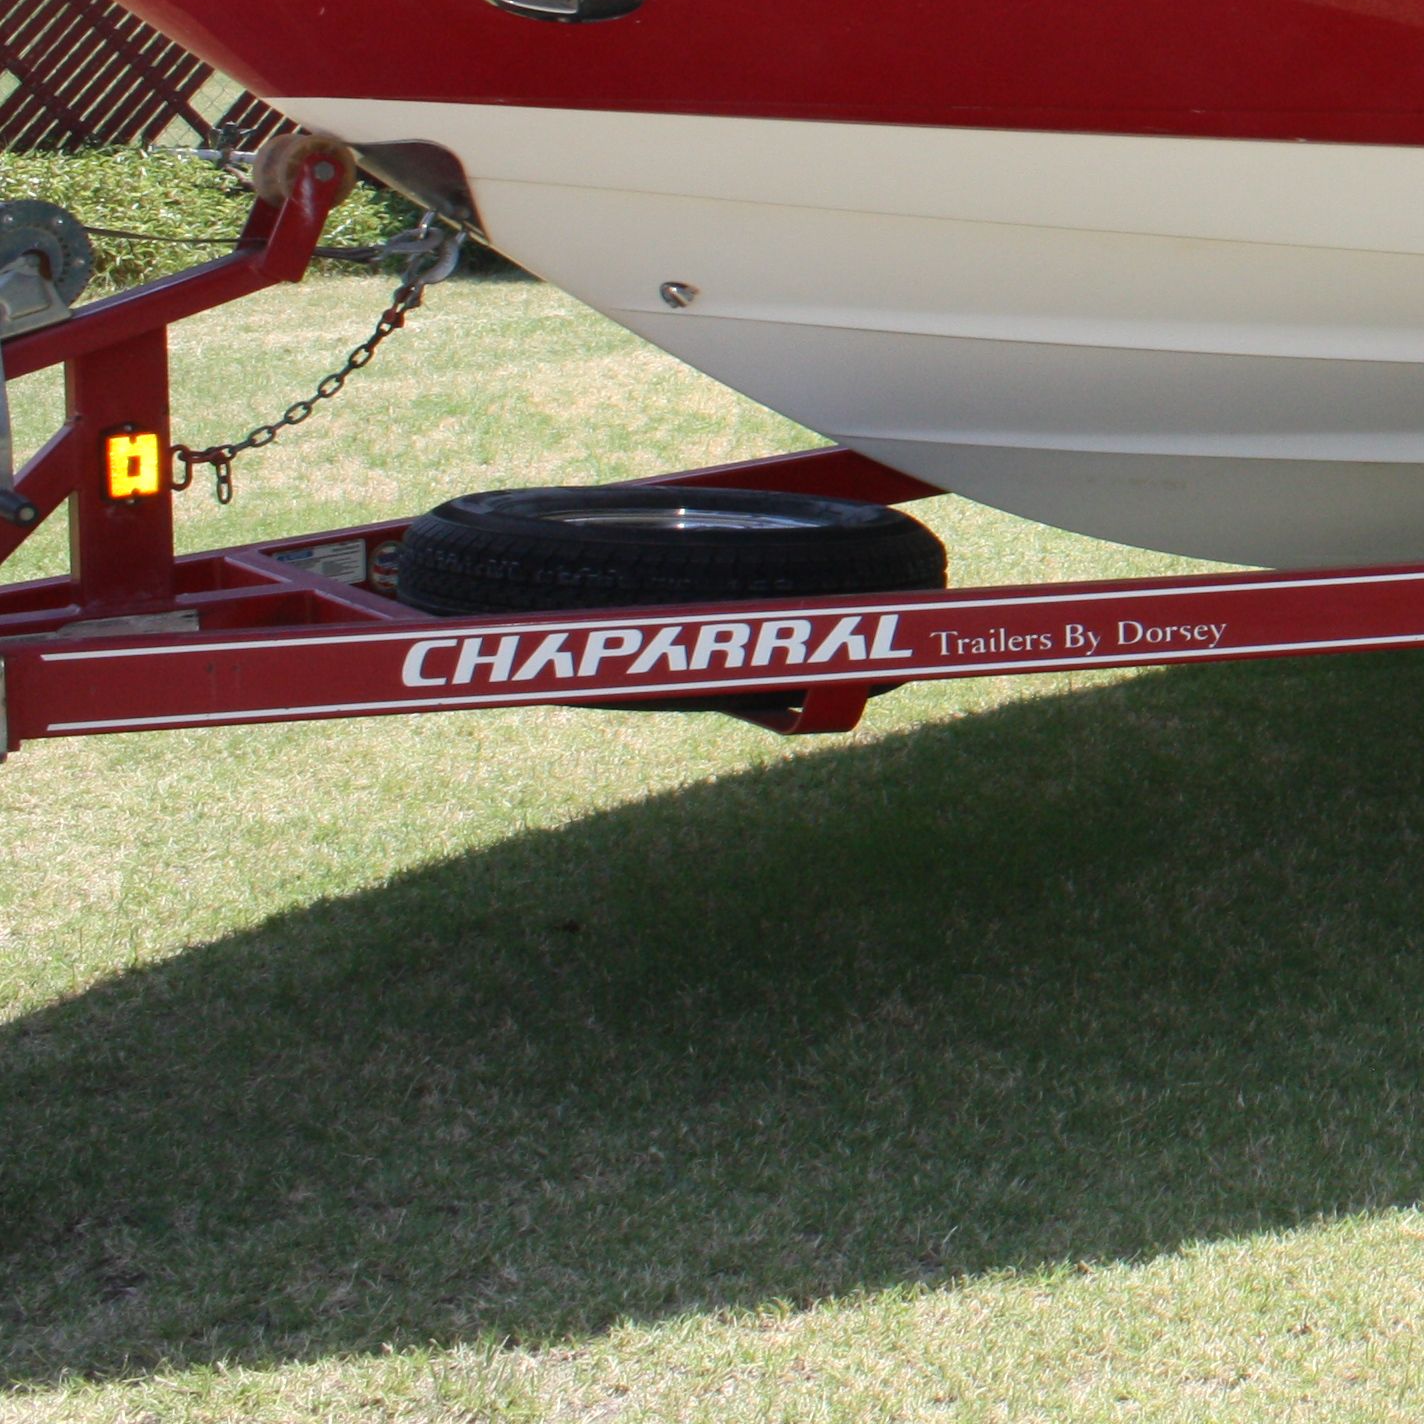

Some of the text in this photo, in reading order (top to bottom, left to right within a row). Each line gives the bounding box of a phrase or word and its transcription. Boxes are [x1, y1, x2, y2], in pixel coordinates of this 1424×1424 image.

[401, 613, 913, 688] CHAPARRAL
[929, 620, 1227, 656] Trailers By Dorsey
